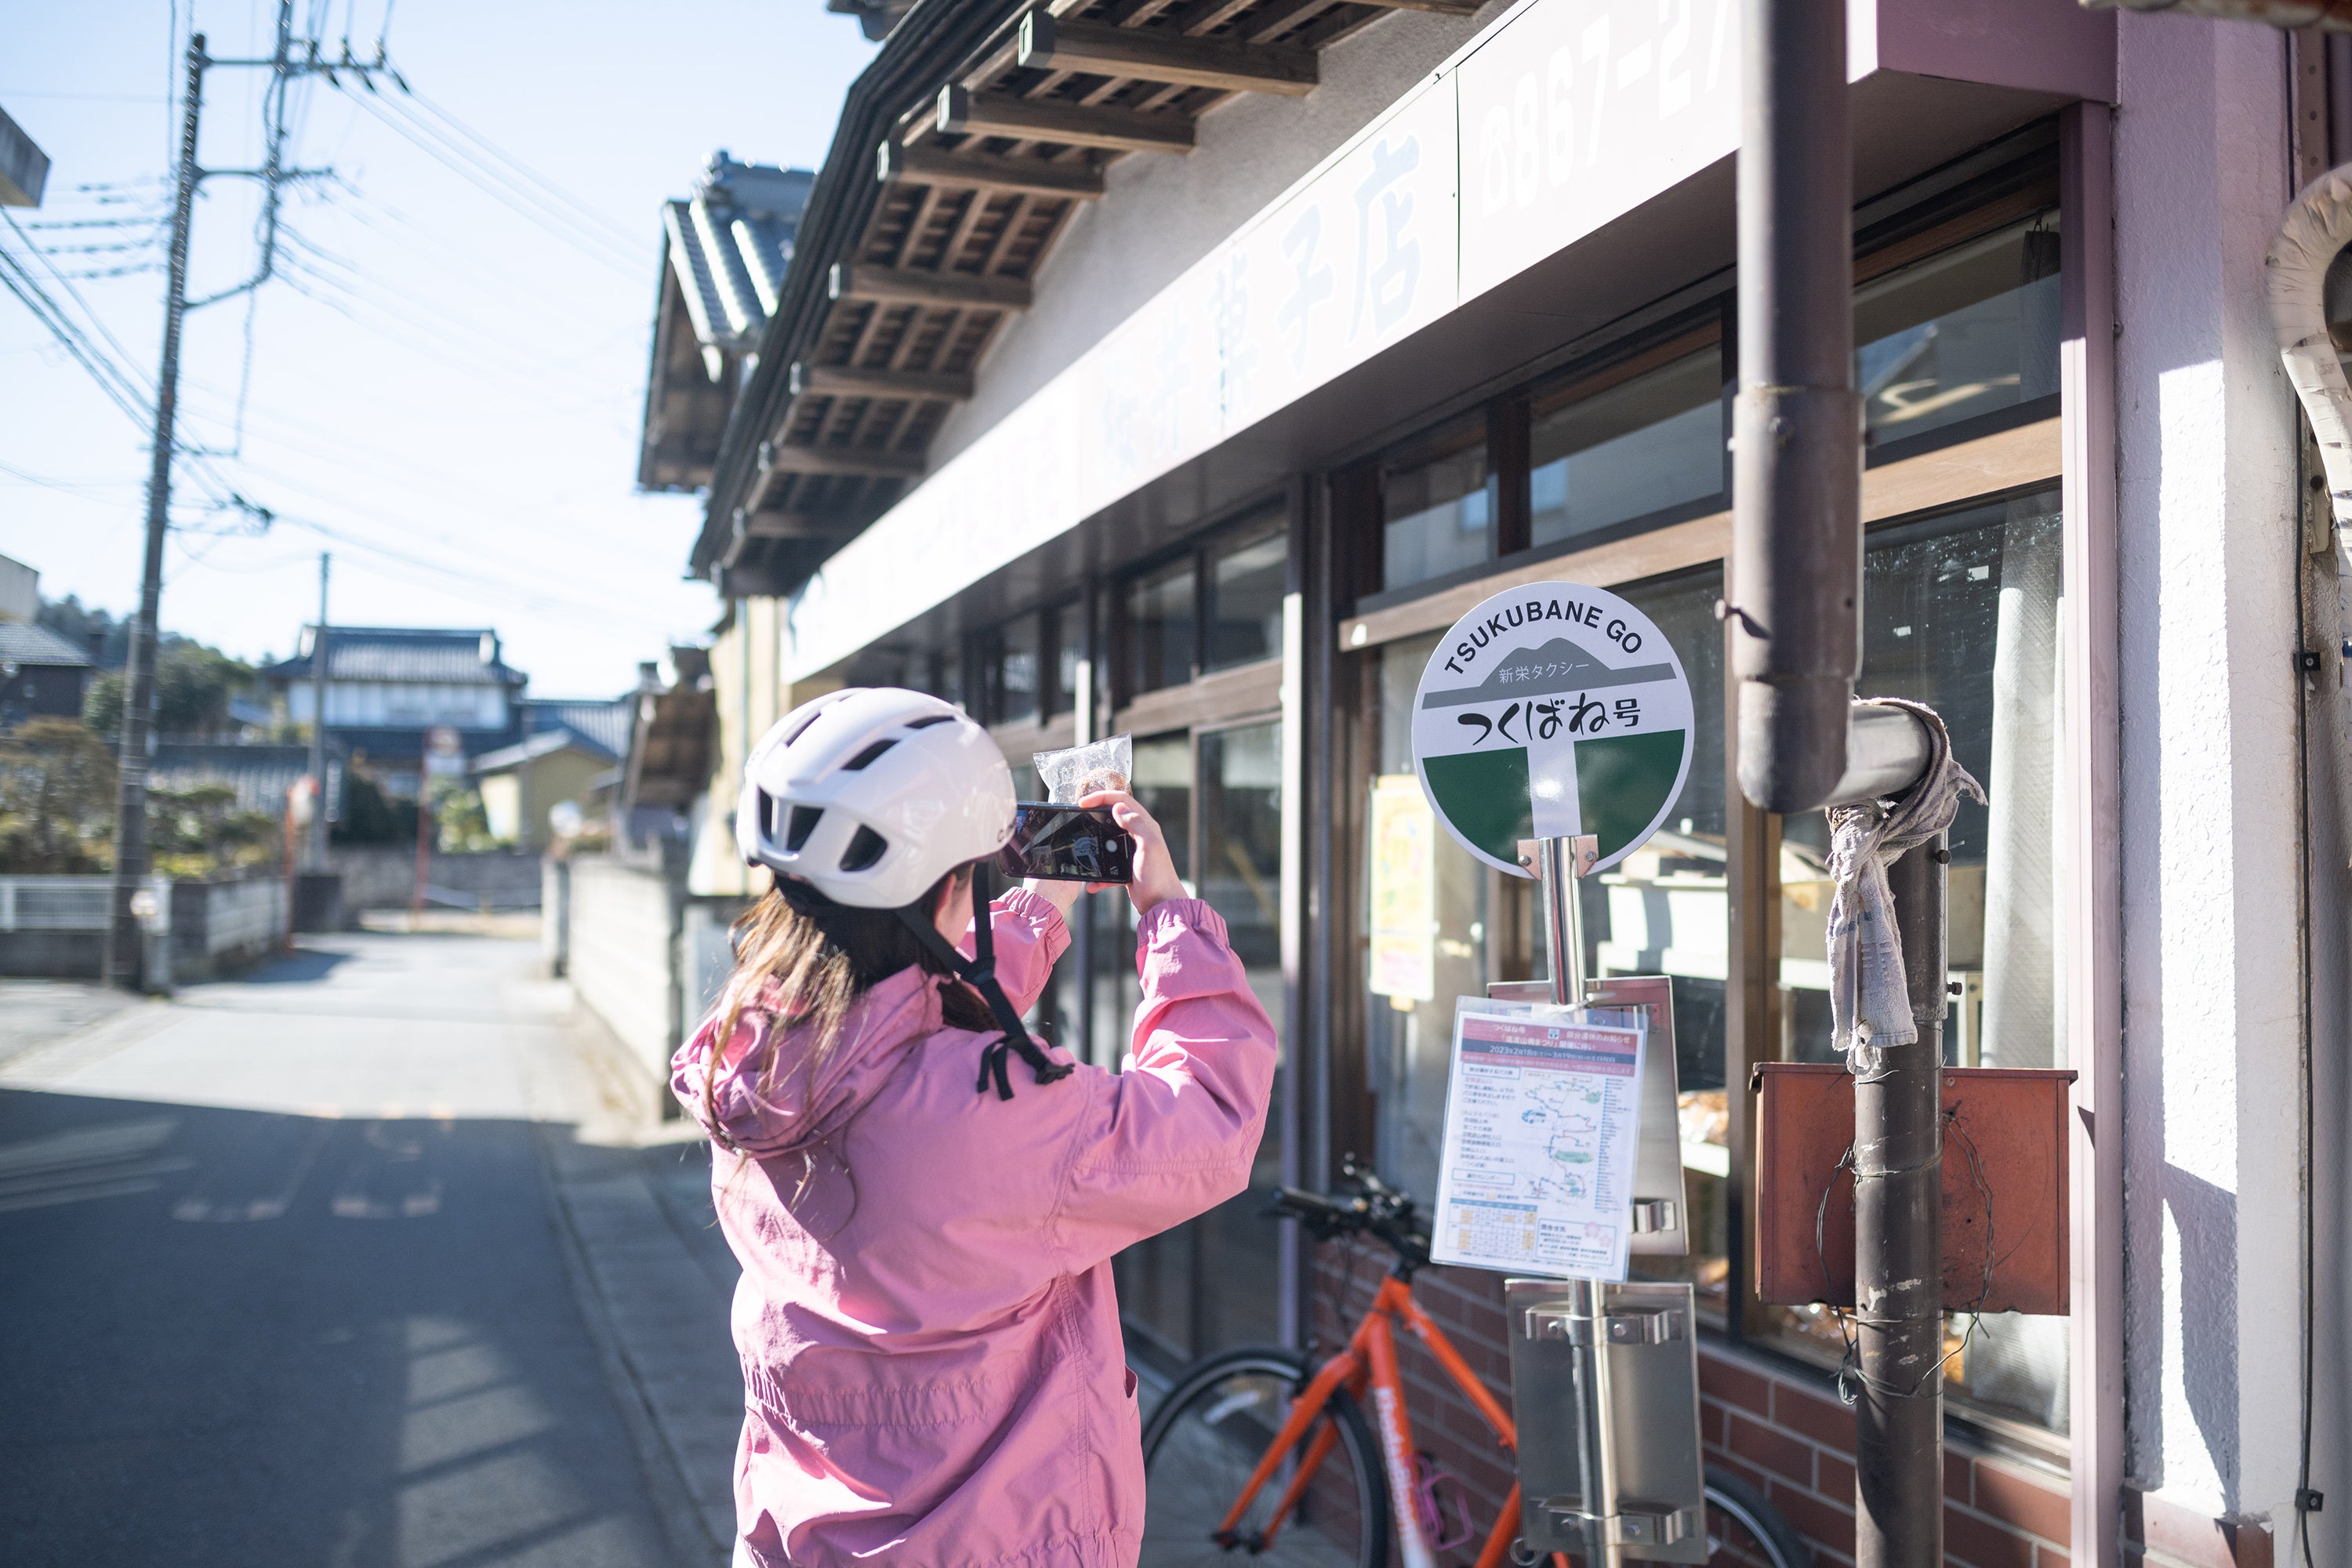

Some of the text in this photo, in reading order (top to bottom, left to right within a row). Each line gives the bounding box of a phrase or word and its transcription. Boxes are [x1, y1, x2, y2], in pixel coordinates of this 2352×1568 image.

[1444, 600, 1642, 674] TSUKUBANE GO
[1499, 661, 1589, 684] 新栄タクシー
[1457, 692, 1640, 746] つくばね号
